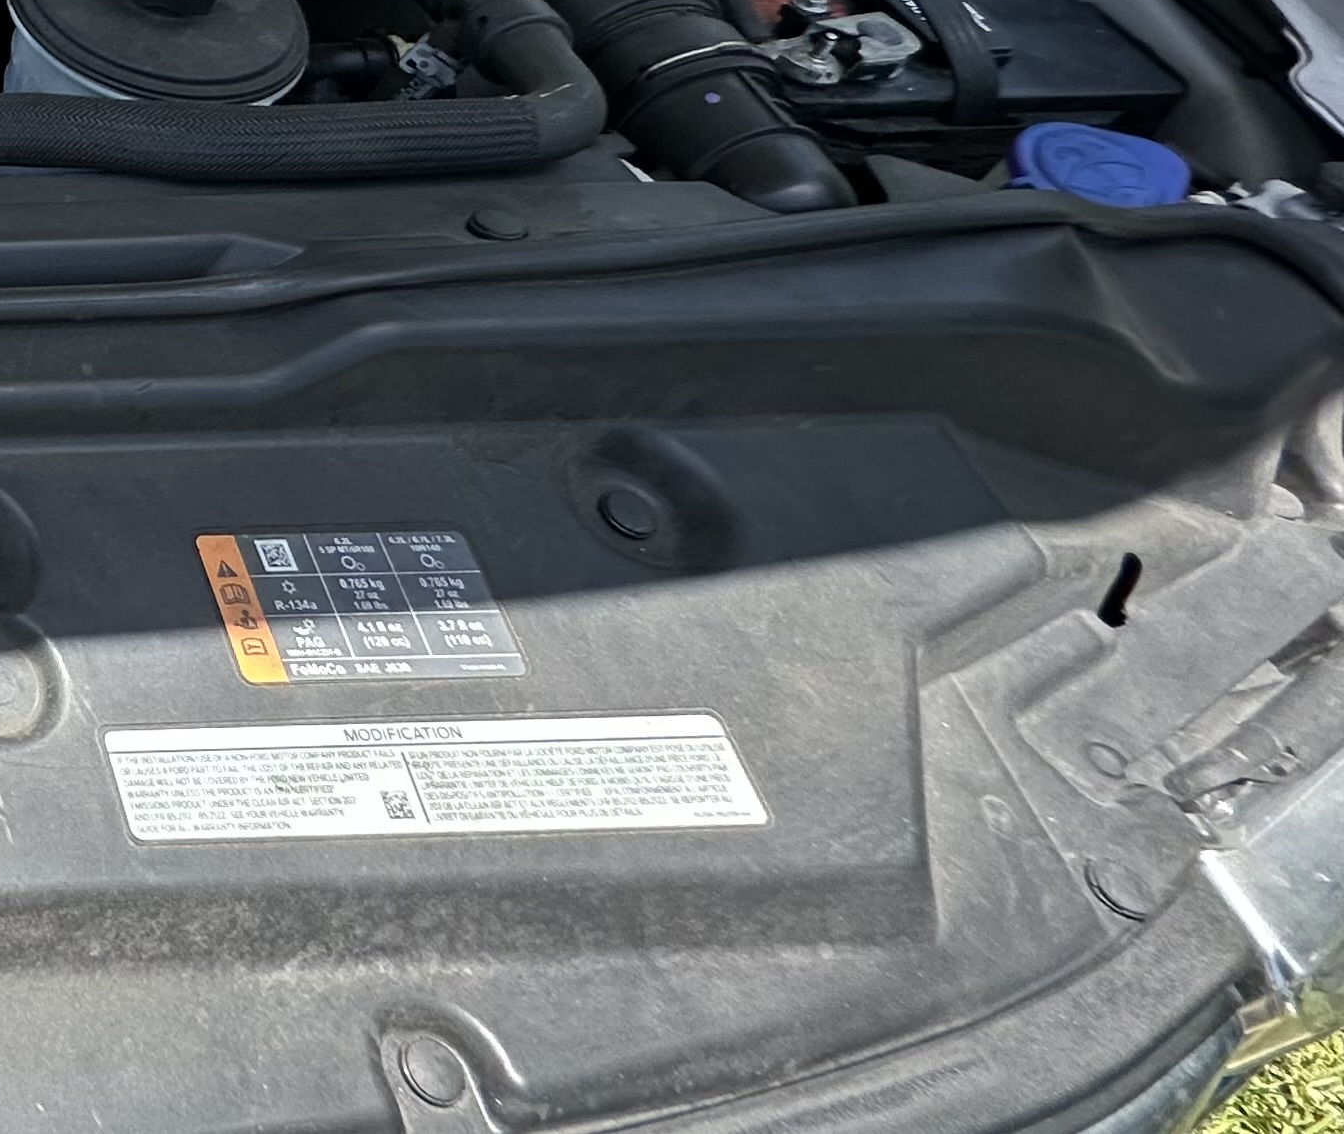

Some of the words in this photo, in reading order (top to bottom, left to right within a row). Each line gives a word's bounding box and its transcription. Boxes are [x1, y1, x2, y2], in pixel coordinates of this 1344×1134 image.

[339, 578, 368, 589] 0.765
[369, 578, 386, 591] kg
[418, 577, 447, 588] 0.765
[448, 576, 465, 589] kg
[354, 590, 364, 599] 27
[274, 599, 318, 611] R-134a
[296, 636, 325, 648] PAG
[390, 635, 411, 648] cc)
[289, 663, 347, 676] FoMoCo
[354, 662, 382, 674] SAE
[343, 726, 463, 742] MODIFICATION
